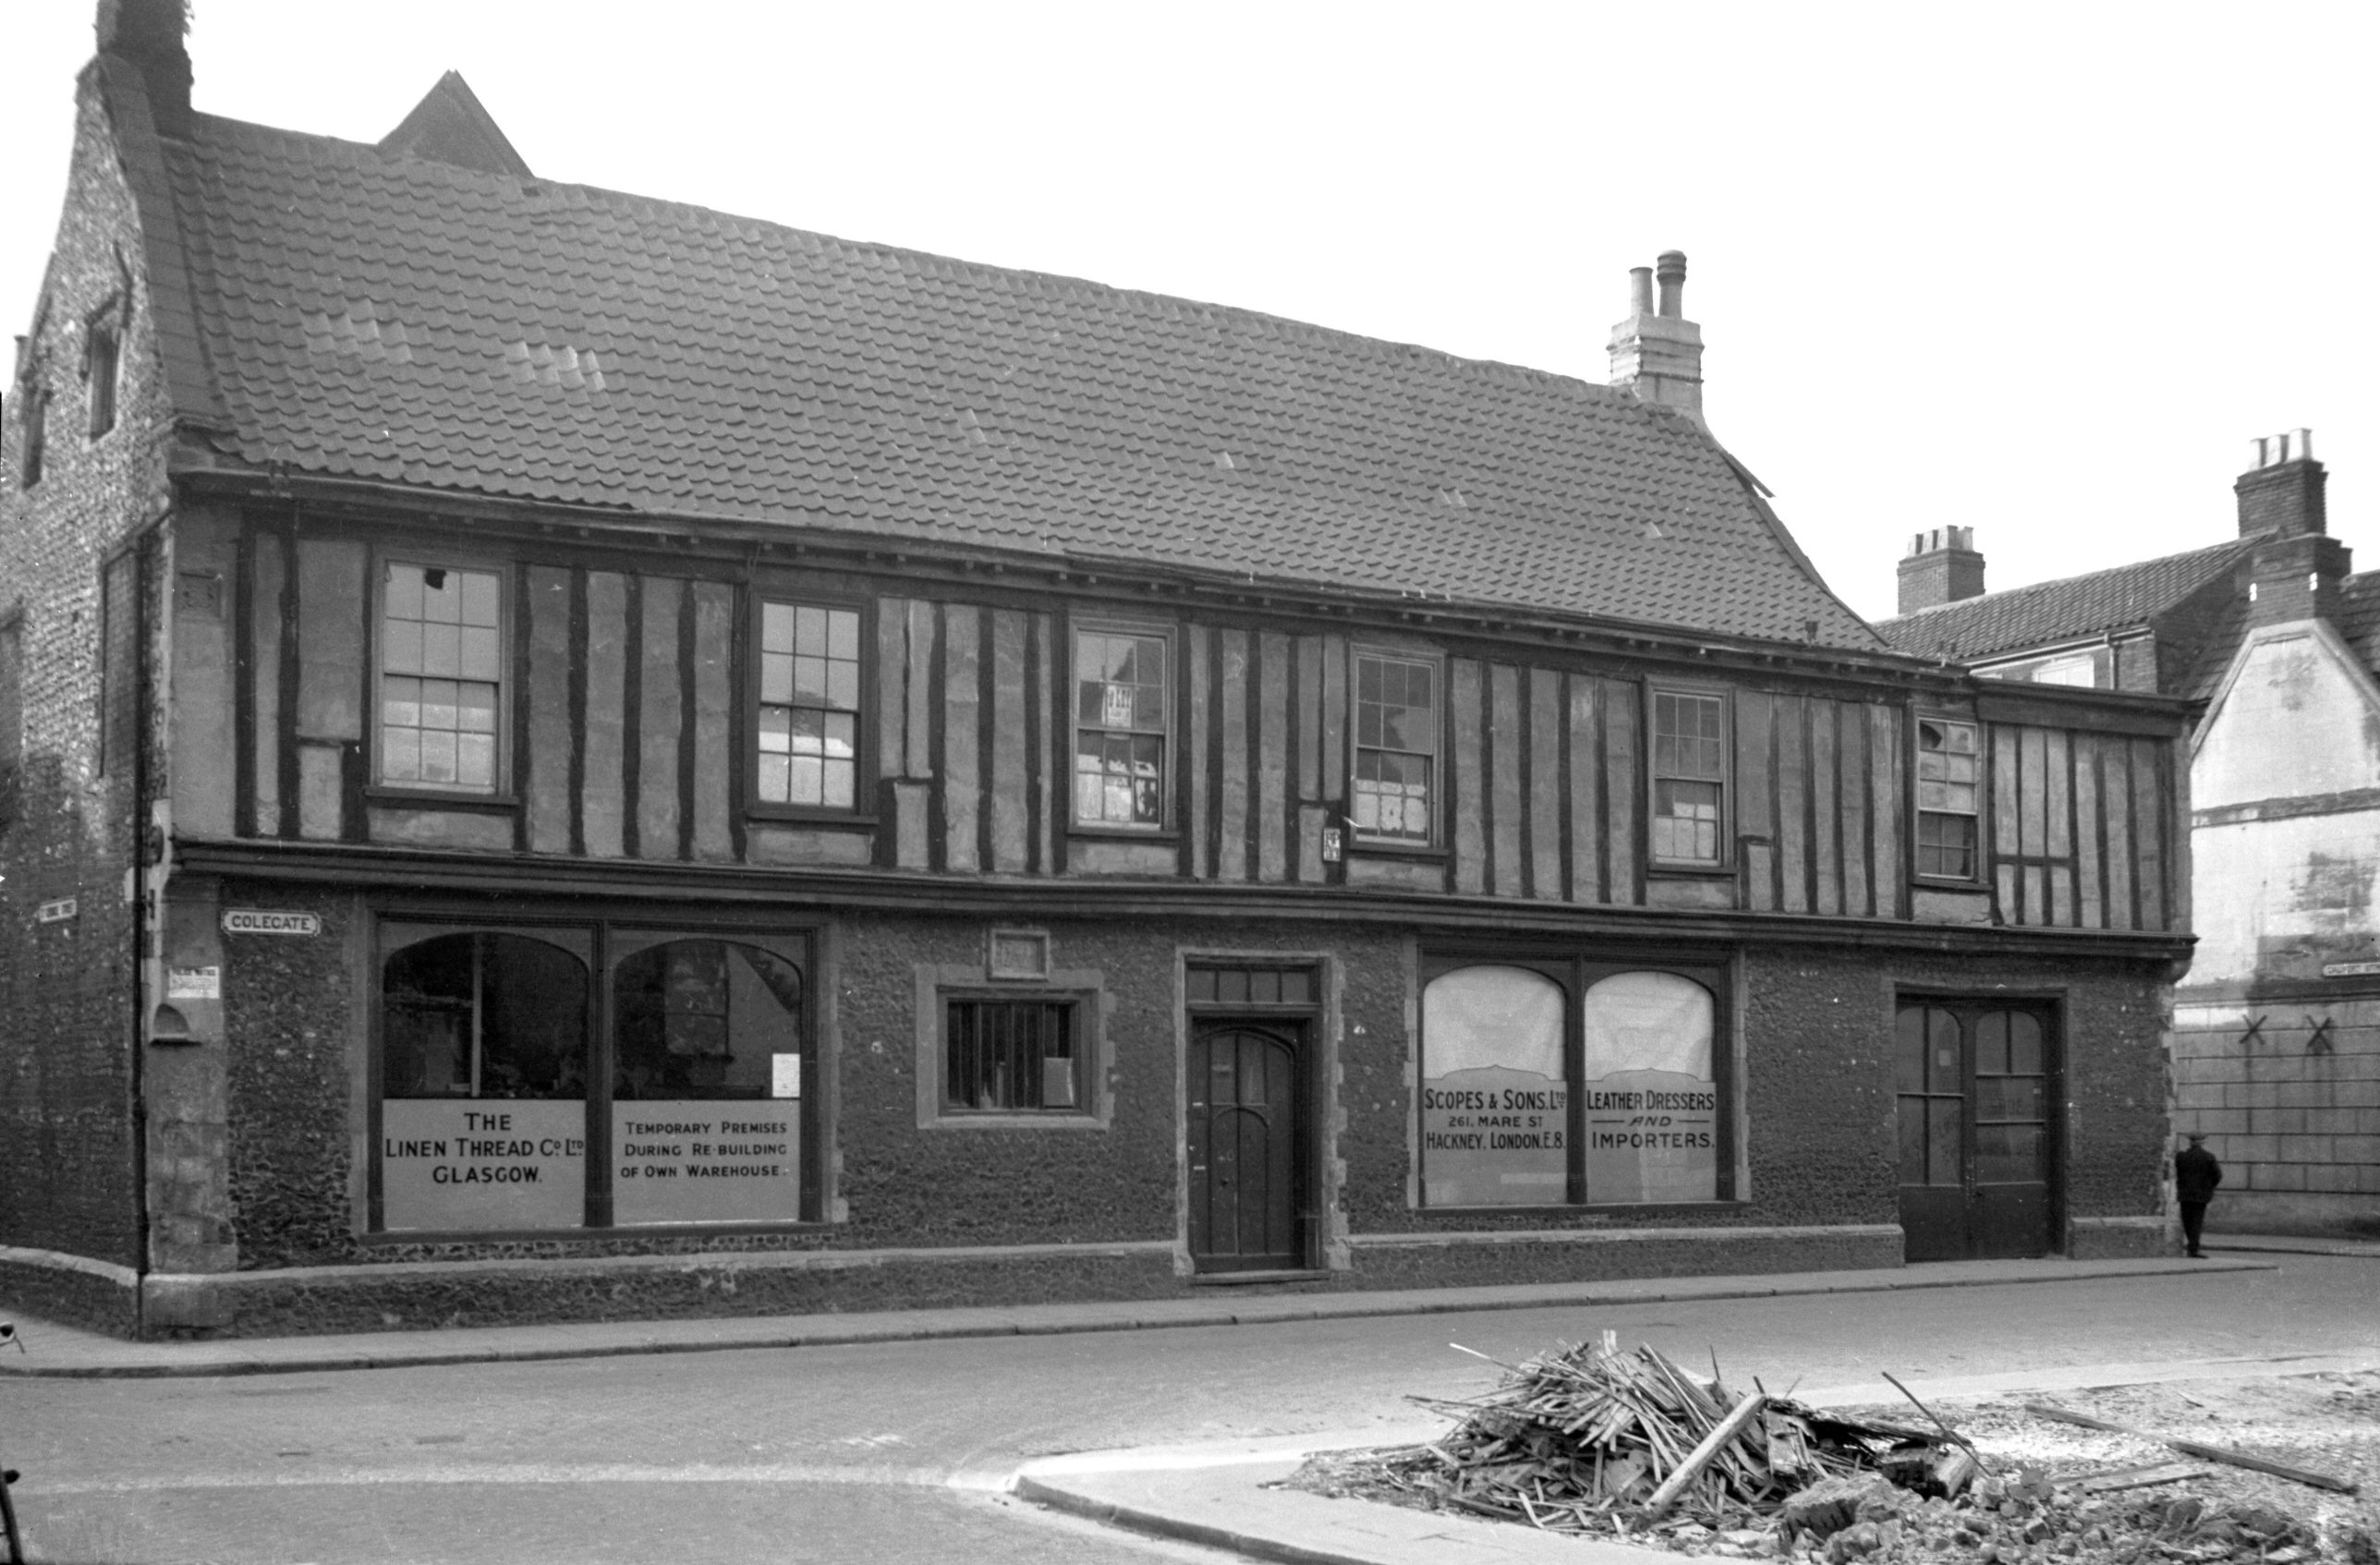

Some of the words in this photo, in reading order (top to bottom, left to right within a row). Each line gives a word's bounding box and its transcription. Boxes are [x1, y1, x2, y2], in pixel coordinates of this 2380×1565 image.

[231, 915, 310, 930] COLEGATE
[1425, 1088, 1484, 1110] SCOPES
[1488, 1093, 1498, 1110] &
[1586, 1089, 1643, 1110] LEATHER
[1645, 1089, 1715, 1110] DRESSERS
[464, 1112, 512, 1131] THE
[625, 1122, 711, 1134] TEMPORARY
[722, 1121, 788, 1134] PREMISES
[1478, 1116, 1522, 1127] MARE
[1629, 1116, 1671, 1126] AND
[385, 1138, 447, 1158] LINEN
[455, 1137, 534, 1157] THREAD
[1593, 1132, 1716, 1148] IMPORTERS.
[625, 1144, 682, 1156] DURING
[432, 1165, 543, 1183] GLASGOW.
[620, 1167, 639, 1178] OF
[644, 1165, 677, 1178] OWN
